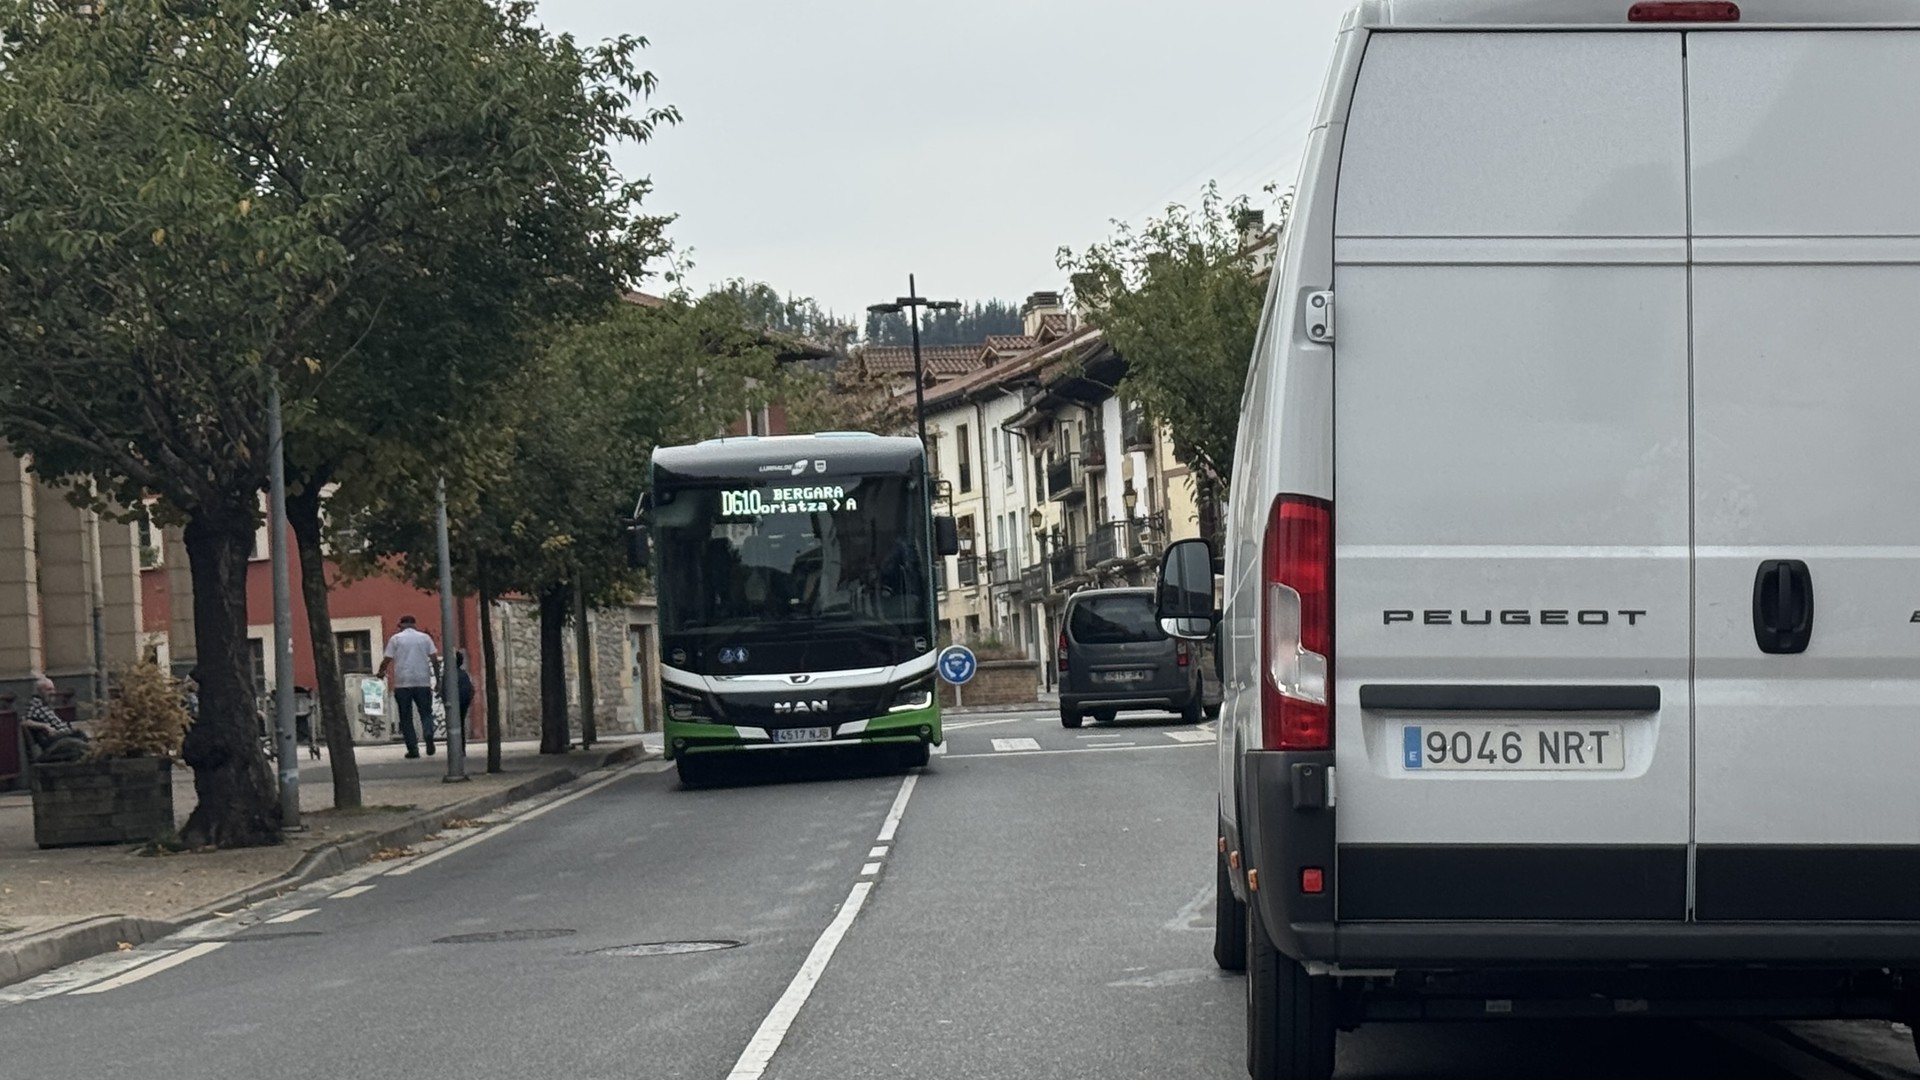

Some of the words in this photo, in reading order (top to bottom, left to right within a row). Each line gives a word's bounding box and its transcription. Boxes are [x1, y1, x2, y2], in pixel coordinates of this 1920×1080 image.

[773, 486, 844, 501] BERGARA
[1383, 610, 1647, 625] PEUGEOT
[774, 700, 828, 714] MAN
[780, 729, 806, 741] 4517
[1426, 731, 1523, 764] 9046
[1538, 730, 1610, 764] NRT
